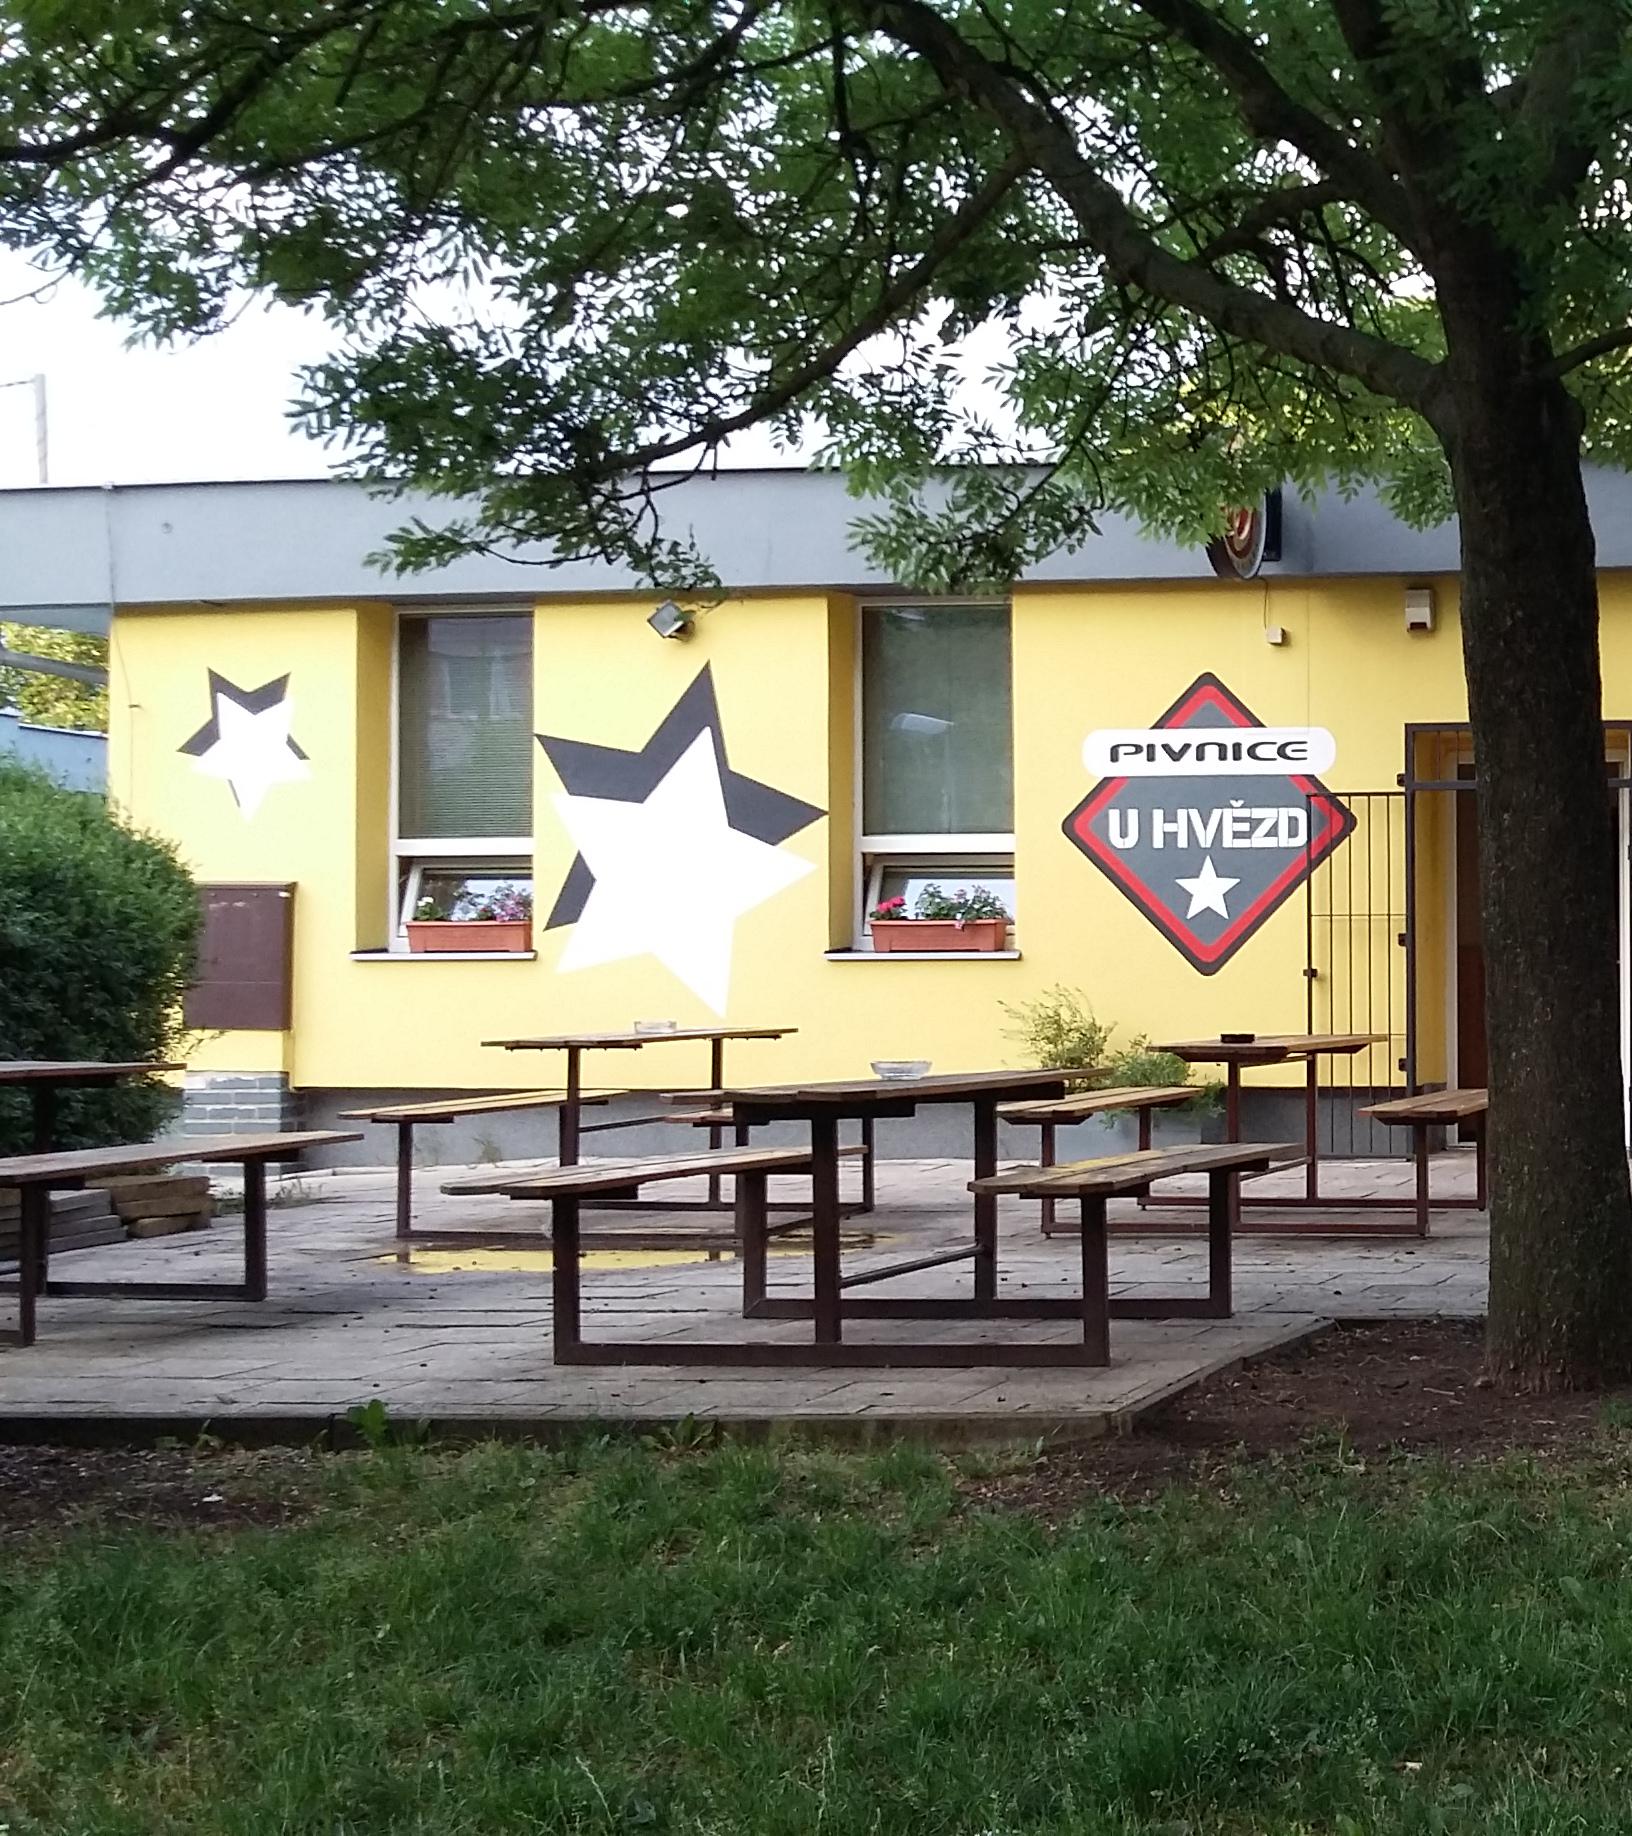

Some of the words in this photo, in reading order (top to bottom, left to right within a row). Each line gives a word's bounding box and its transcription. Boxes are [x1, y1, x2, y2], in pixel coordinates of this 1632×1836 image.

[1109, 740, 1309, 763] PIVNICE
[1108, 808, 1140, 849] U
[1152, 800, 1308, 849] HVĚZD
